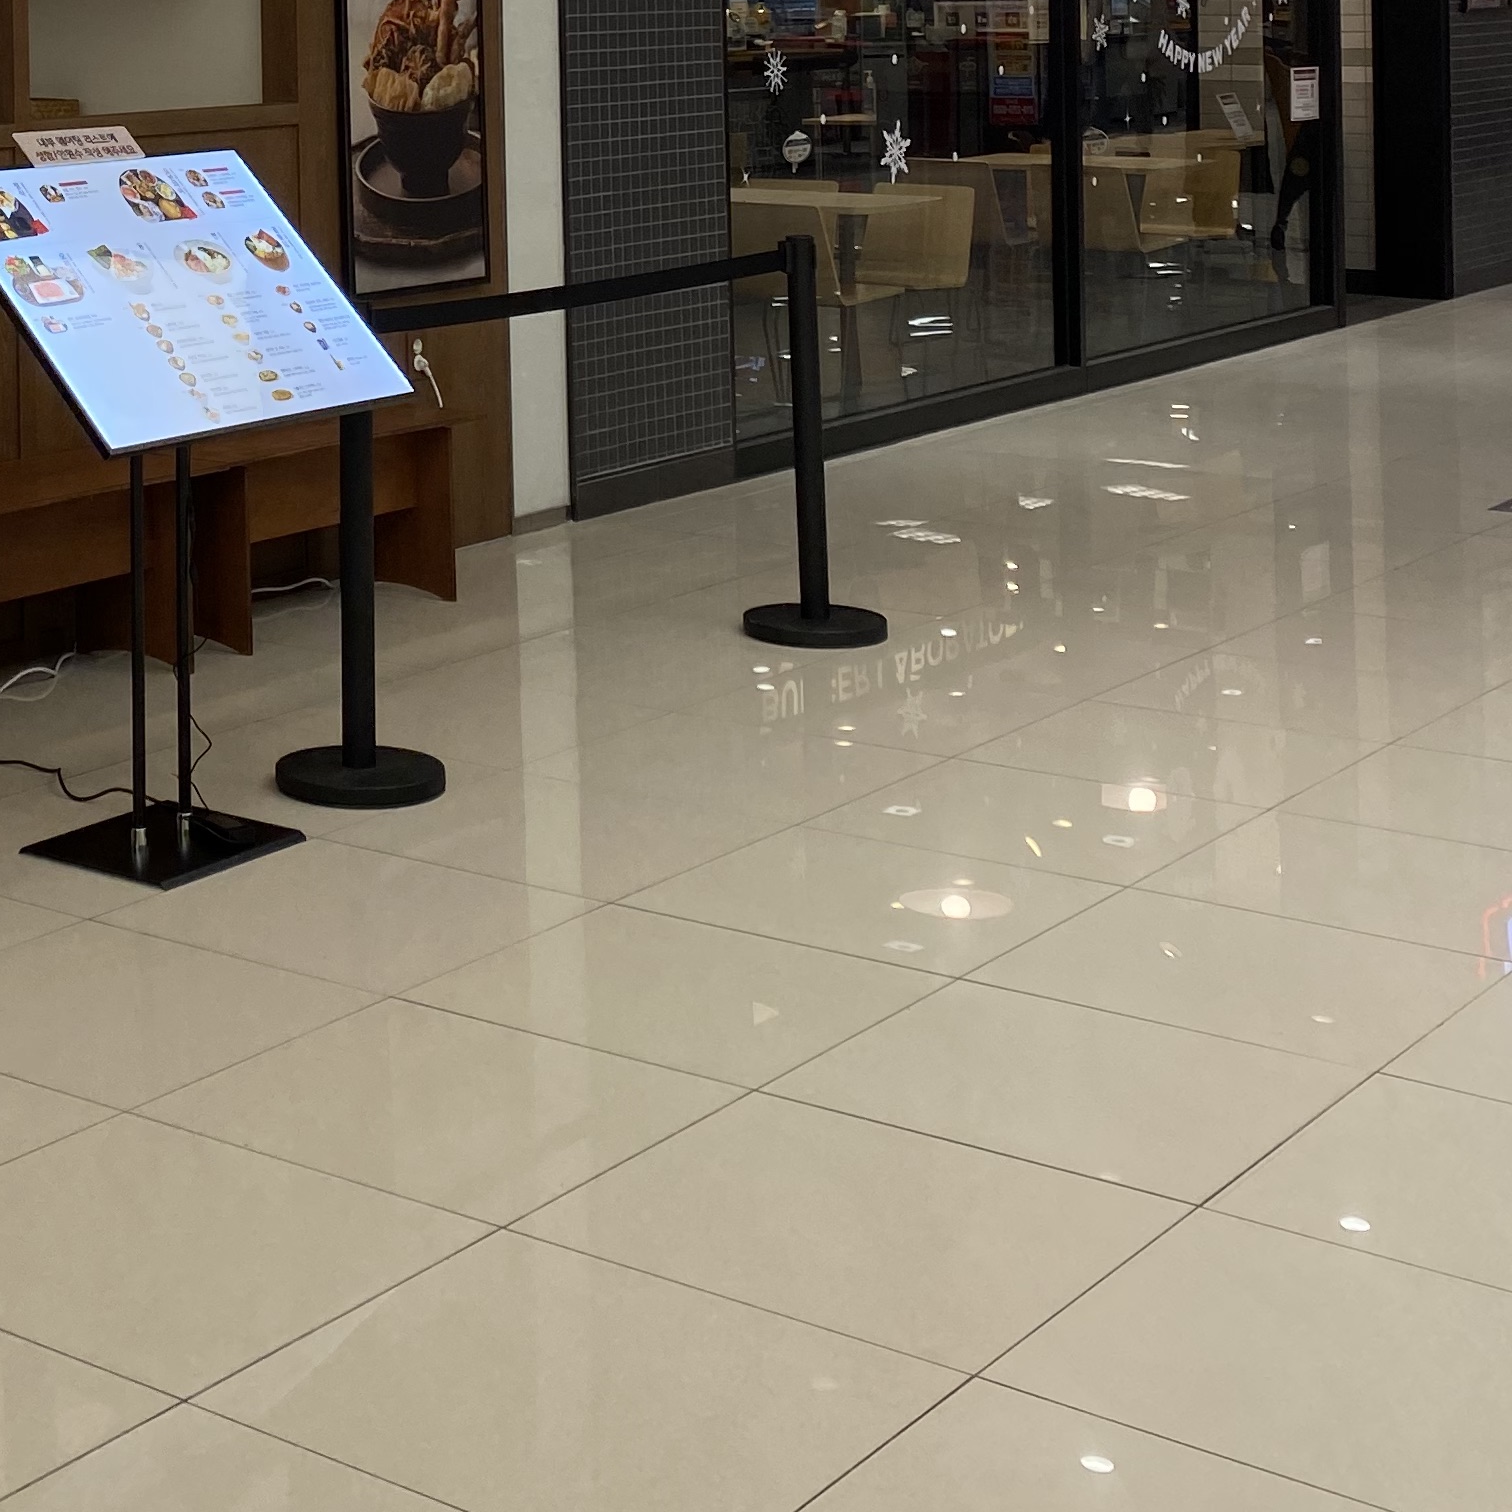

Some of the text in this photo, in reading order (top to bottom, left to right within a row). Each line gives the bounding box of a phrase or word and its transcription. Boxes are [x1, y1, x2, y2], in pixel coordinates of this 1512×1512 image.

[1158, 6, 1251, 74] HAPPY NEW YEAR
[83, 133, 118, 144] 리스트에
[83, 148, 103, 158] 작성
